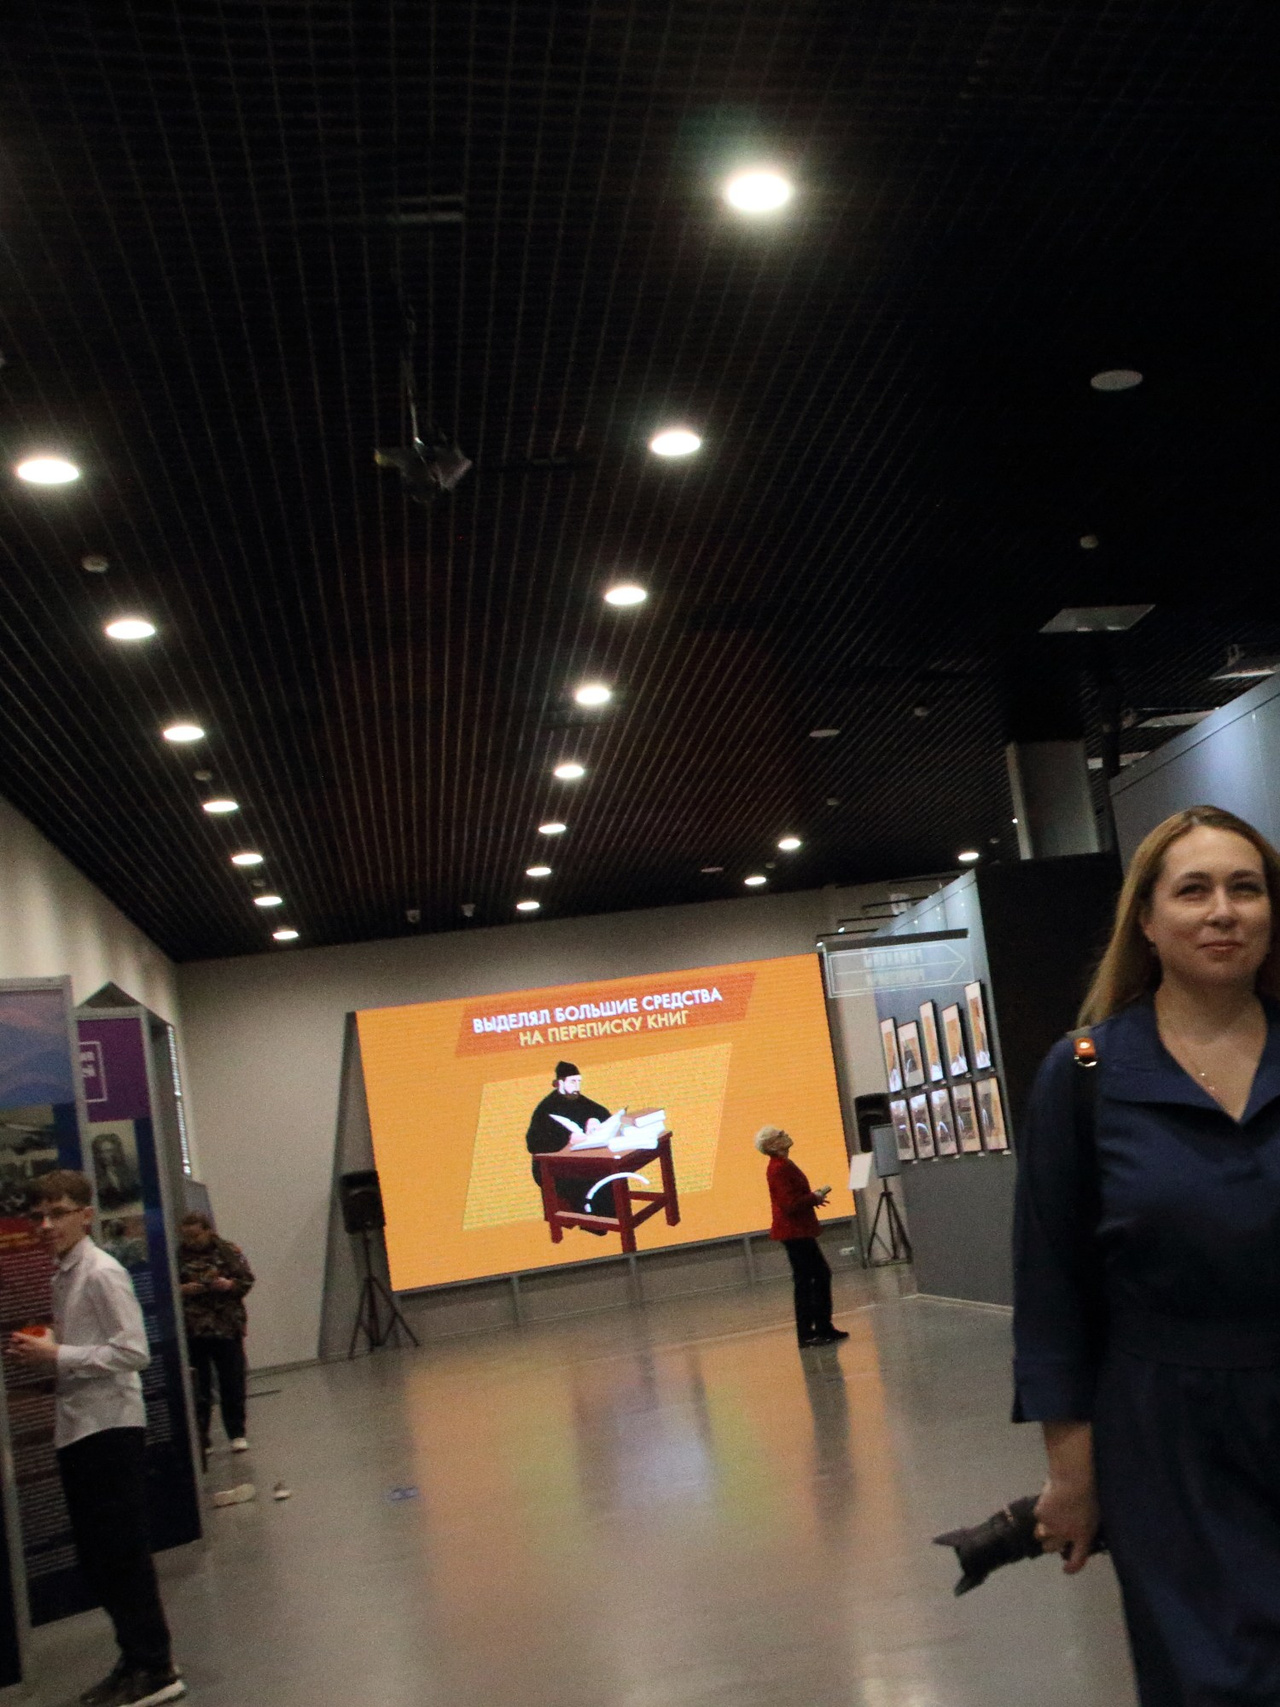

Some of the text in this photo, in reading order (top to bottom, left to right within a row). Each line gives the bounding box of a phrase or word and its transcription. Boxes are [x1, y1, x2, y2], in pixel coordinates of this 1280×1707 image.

[472, 987, 723, 1033] ВЫДЕЛЯЛ БОЛЬШИЕ СРЕДСТВА
[518, 1010, 691, 1046] НА ПЕРЕПИСКУ КНИГ
